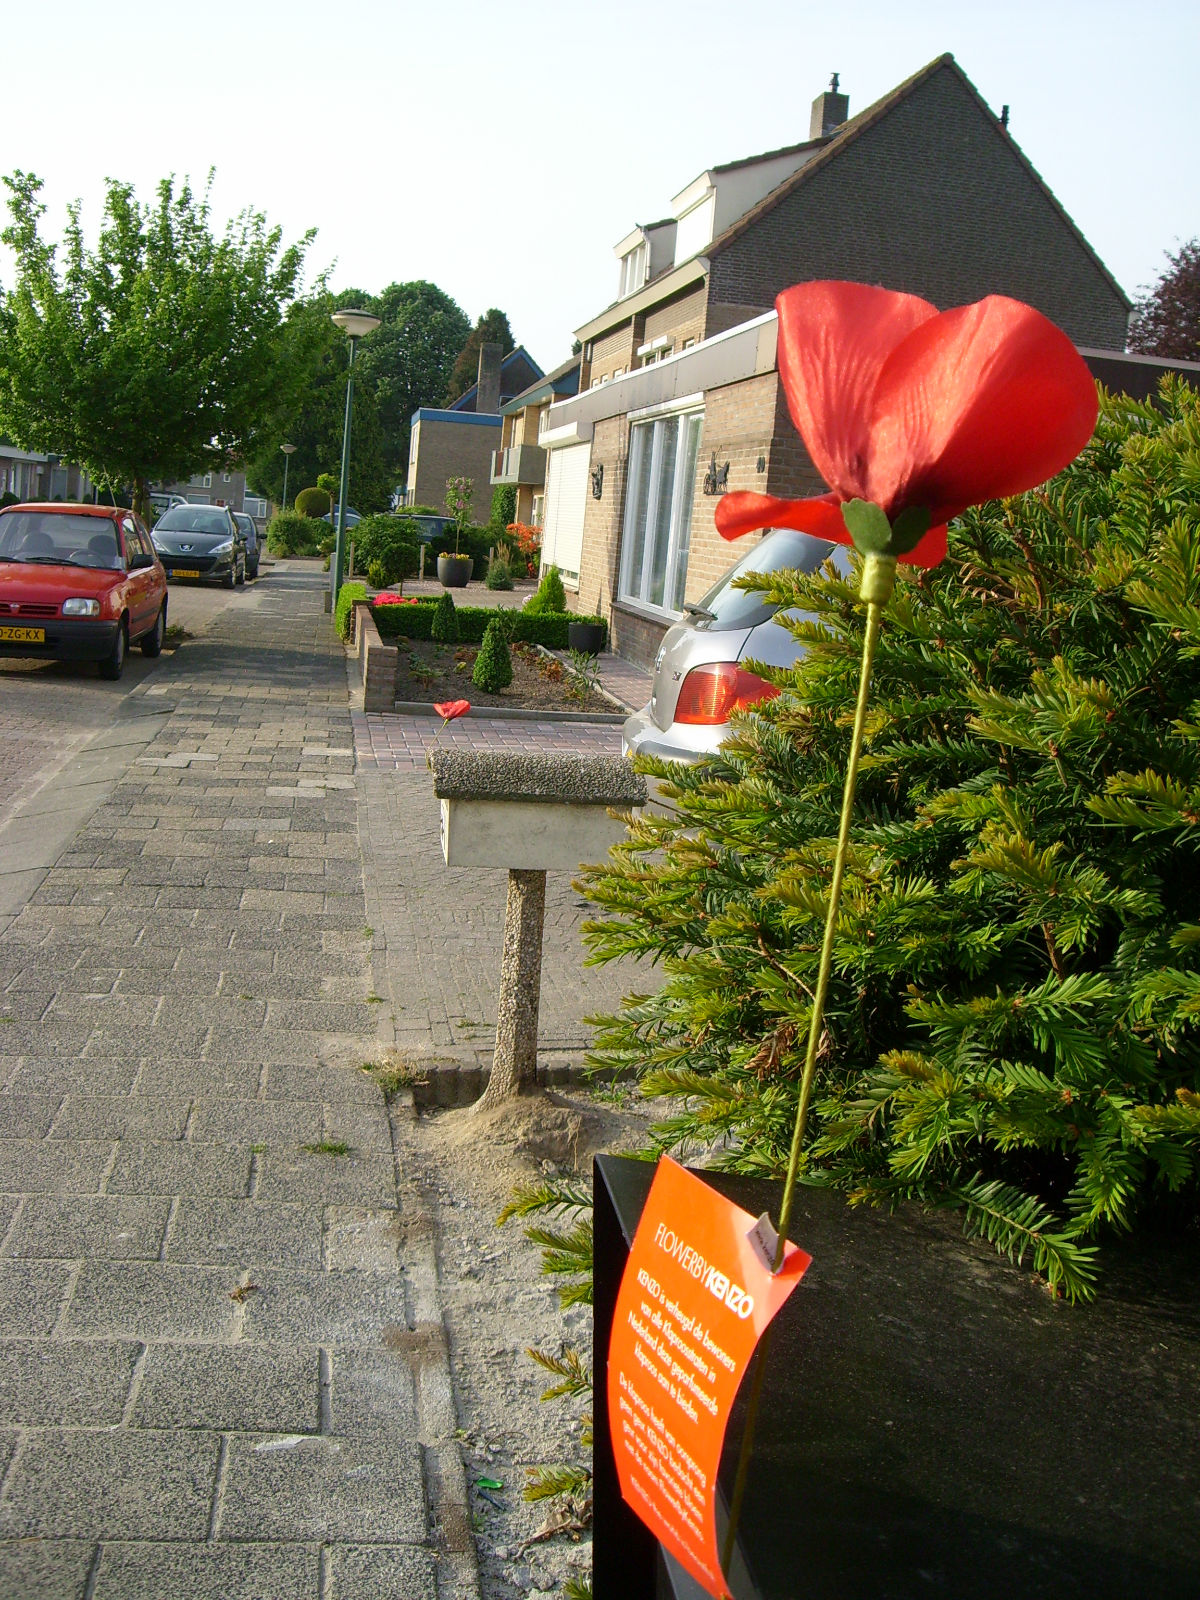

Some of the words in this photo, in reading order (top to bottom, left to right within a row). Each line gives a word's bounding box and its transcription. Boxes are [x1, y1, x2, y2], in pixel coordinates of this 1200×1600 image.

[653, 1222, 755, 1320] FLOWERBYKENZO
[627, 1310, 659, 1351] Nederland
[656, 1341, 673, 1367] deze
[636, 1267, 661, 1298] KENZO
[659, 1289, 666, 1305] is
[665, 1298, 697, 1331] verheugd
[693, 1315, 703, 1341] de
[702, 1329, 737, 1373] bewoners
[640, 1301, 651, 1318] van
[651, 1310, 662, 1330] alle
[707, 1366, 717, 1384] in
[634, 1341, 658, 1378] klaproos
[657, 1372, 670, 1391] aan
